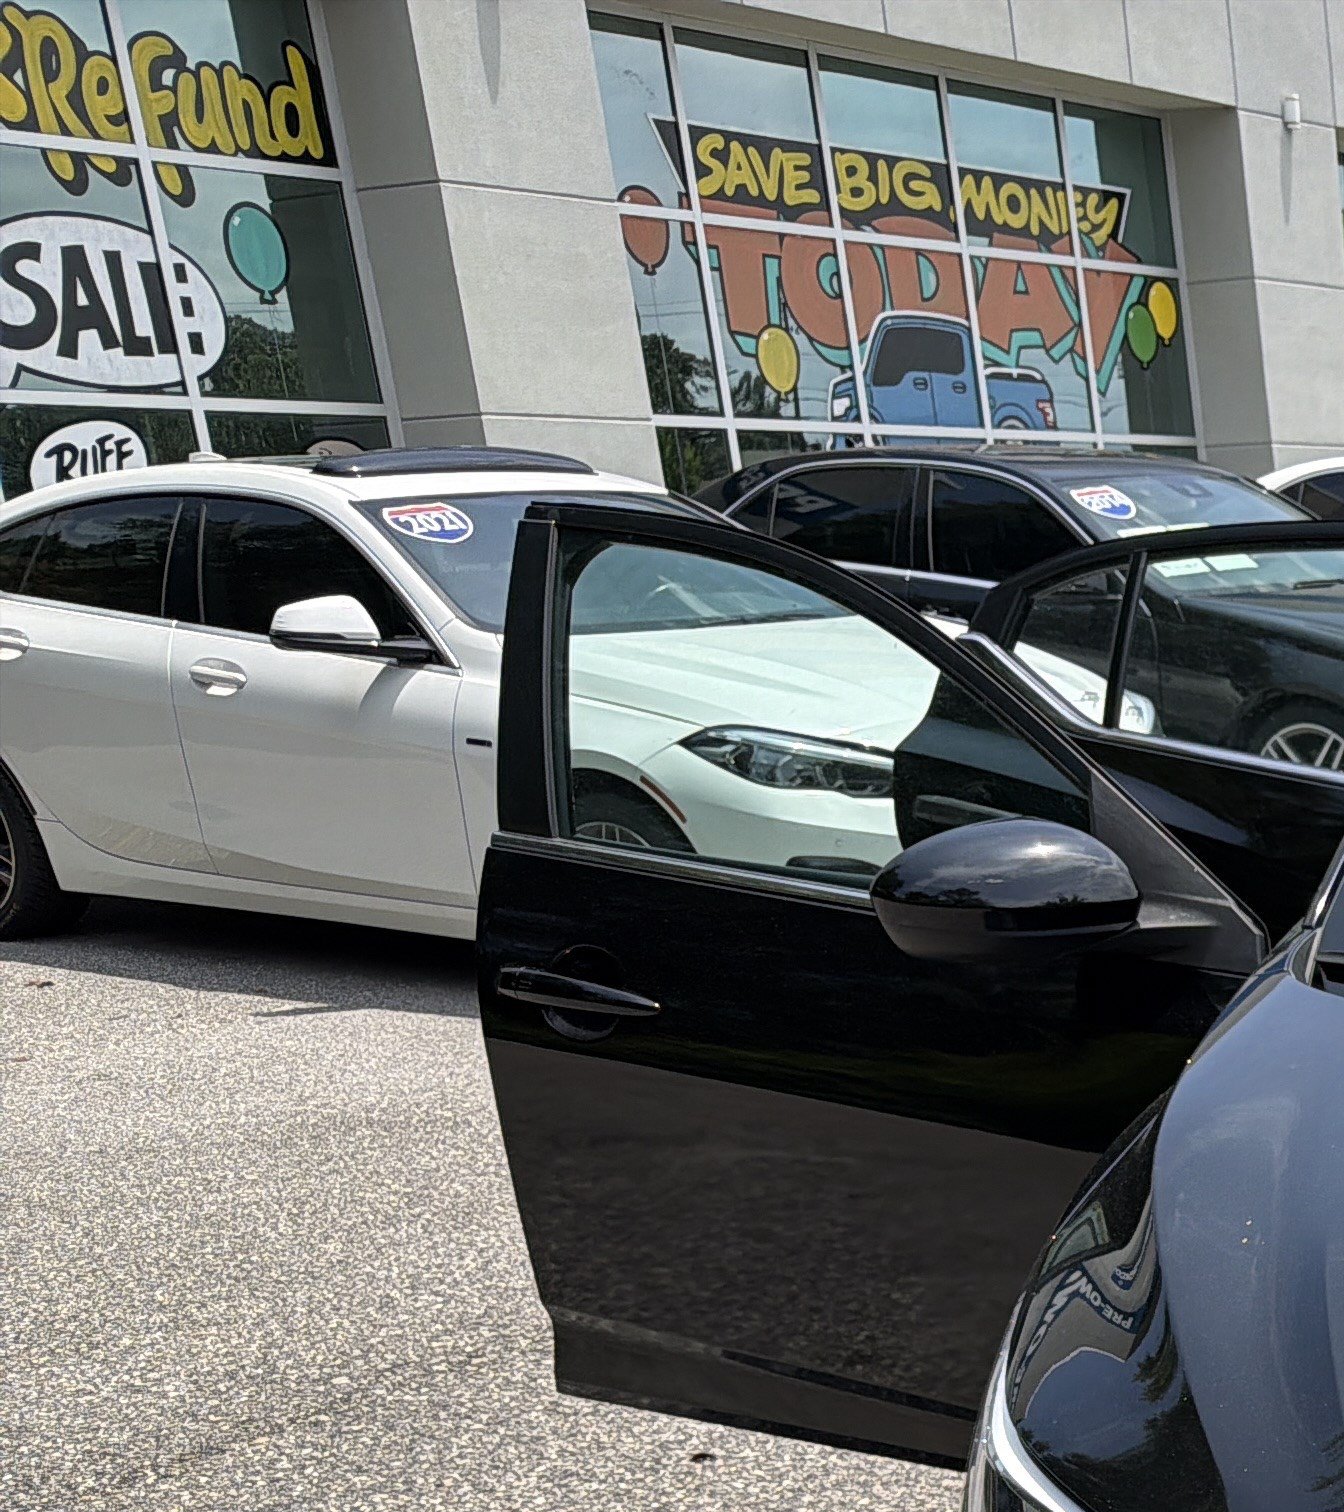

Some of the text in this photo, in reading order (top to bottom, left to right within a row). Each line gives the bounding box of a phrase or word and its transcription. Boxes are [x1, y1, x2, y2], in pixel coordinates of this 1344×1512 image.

[3, 6, 323, 196] Refund
[697, 134, 1119, 248] SAVE BIG MONEY
[0, 242, 205, 360] SALE
[680, 194, 1140, 384] TODAY
[44, 433, 134, 483] RUFF
[399, 511, 467, 533] 2021
